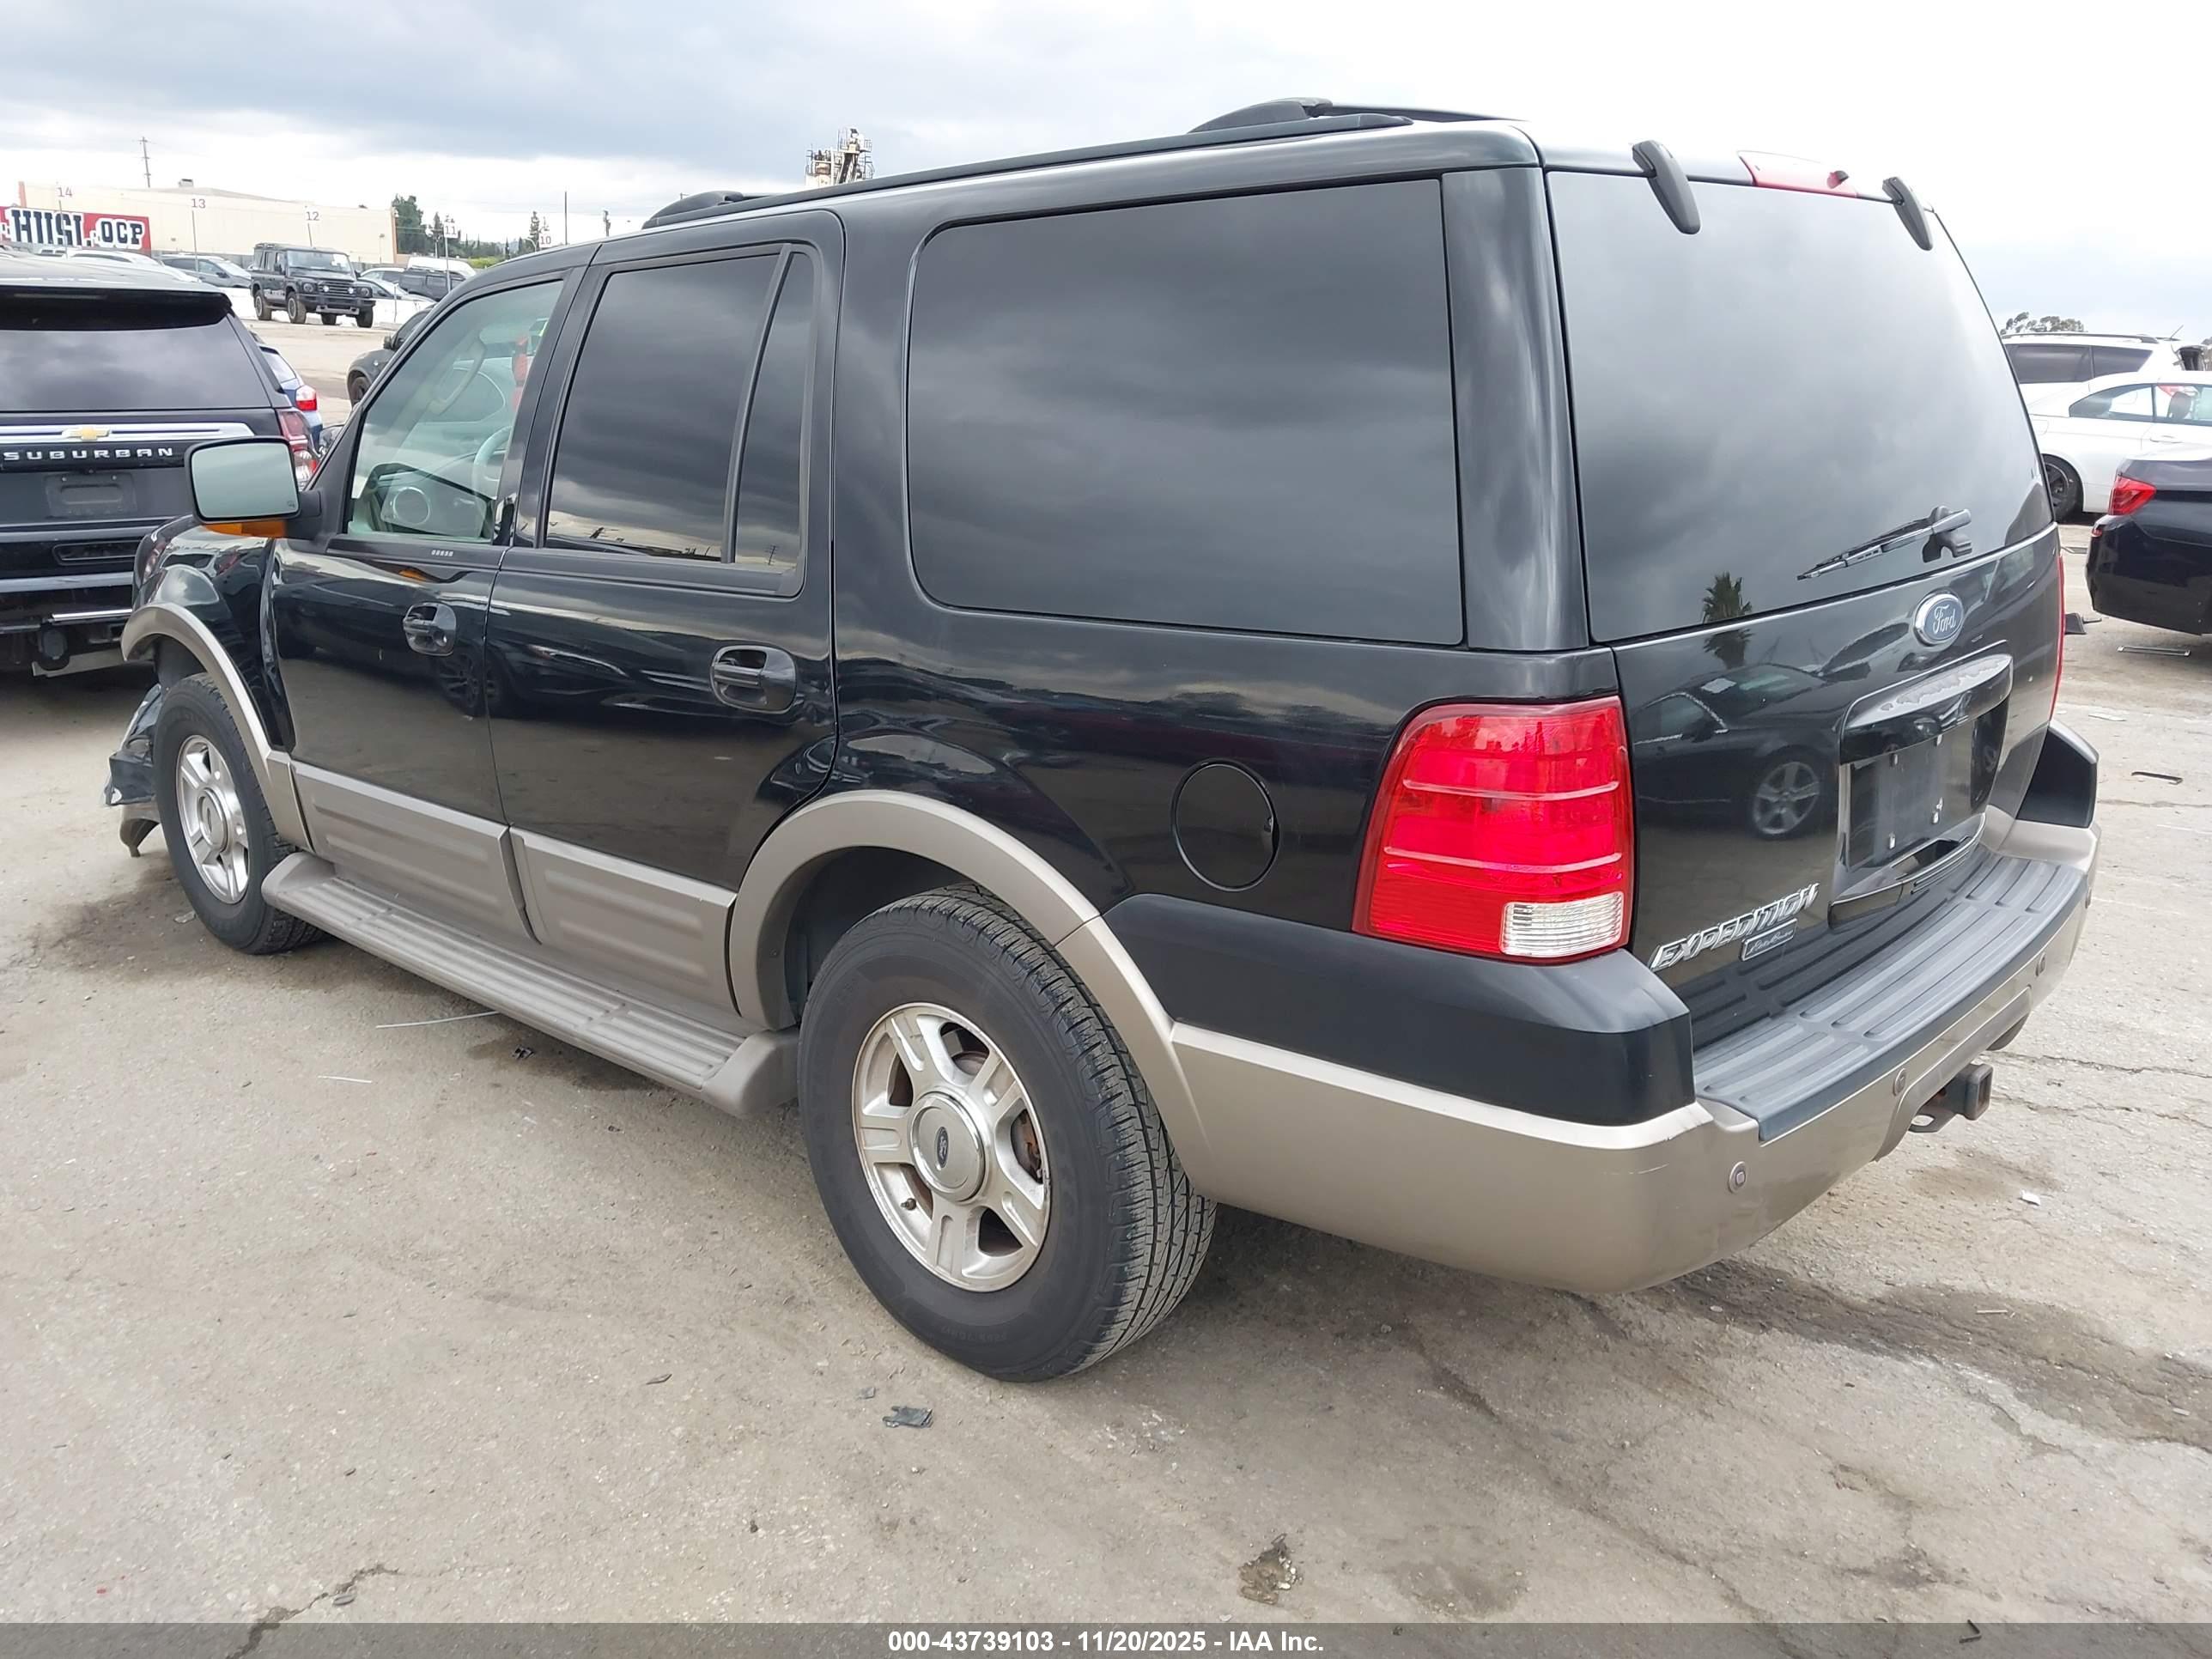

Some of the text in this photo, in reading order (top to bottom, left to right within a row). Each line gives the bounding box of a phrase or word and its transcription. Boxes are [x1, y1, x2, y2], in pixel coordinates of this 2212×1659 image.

[57, 186, 73, 198] 14
[191, 198, 206, 209] 13
[306, 210, 319, 221] 12
[444, 225, 457, 234] 11
[539, 235, 551, 245] 10
[3, 447, 173, 461] SUBURBAN
[1932, 604, 1957, 635] Ford
[1648, 883, 1820, 971] EXPEDITION
